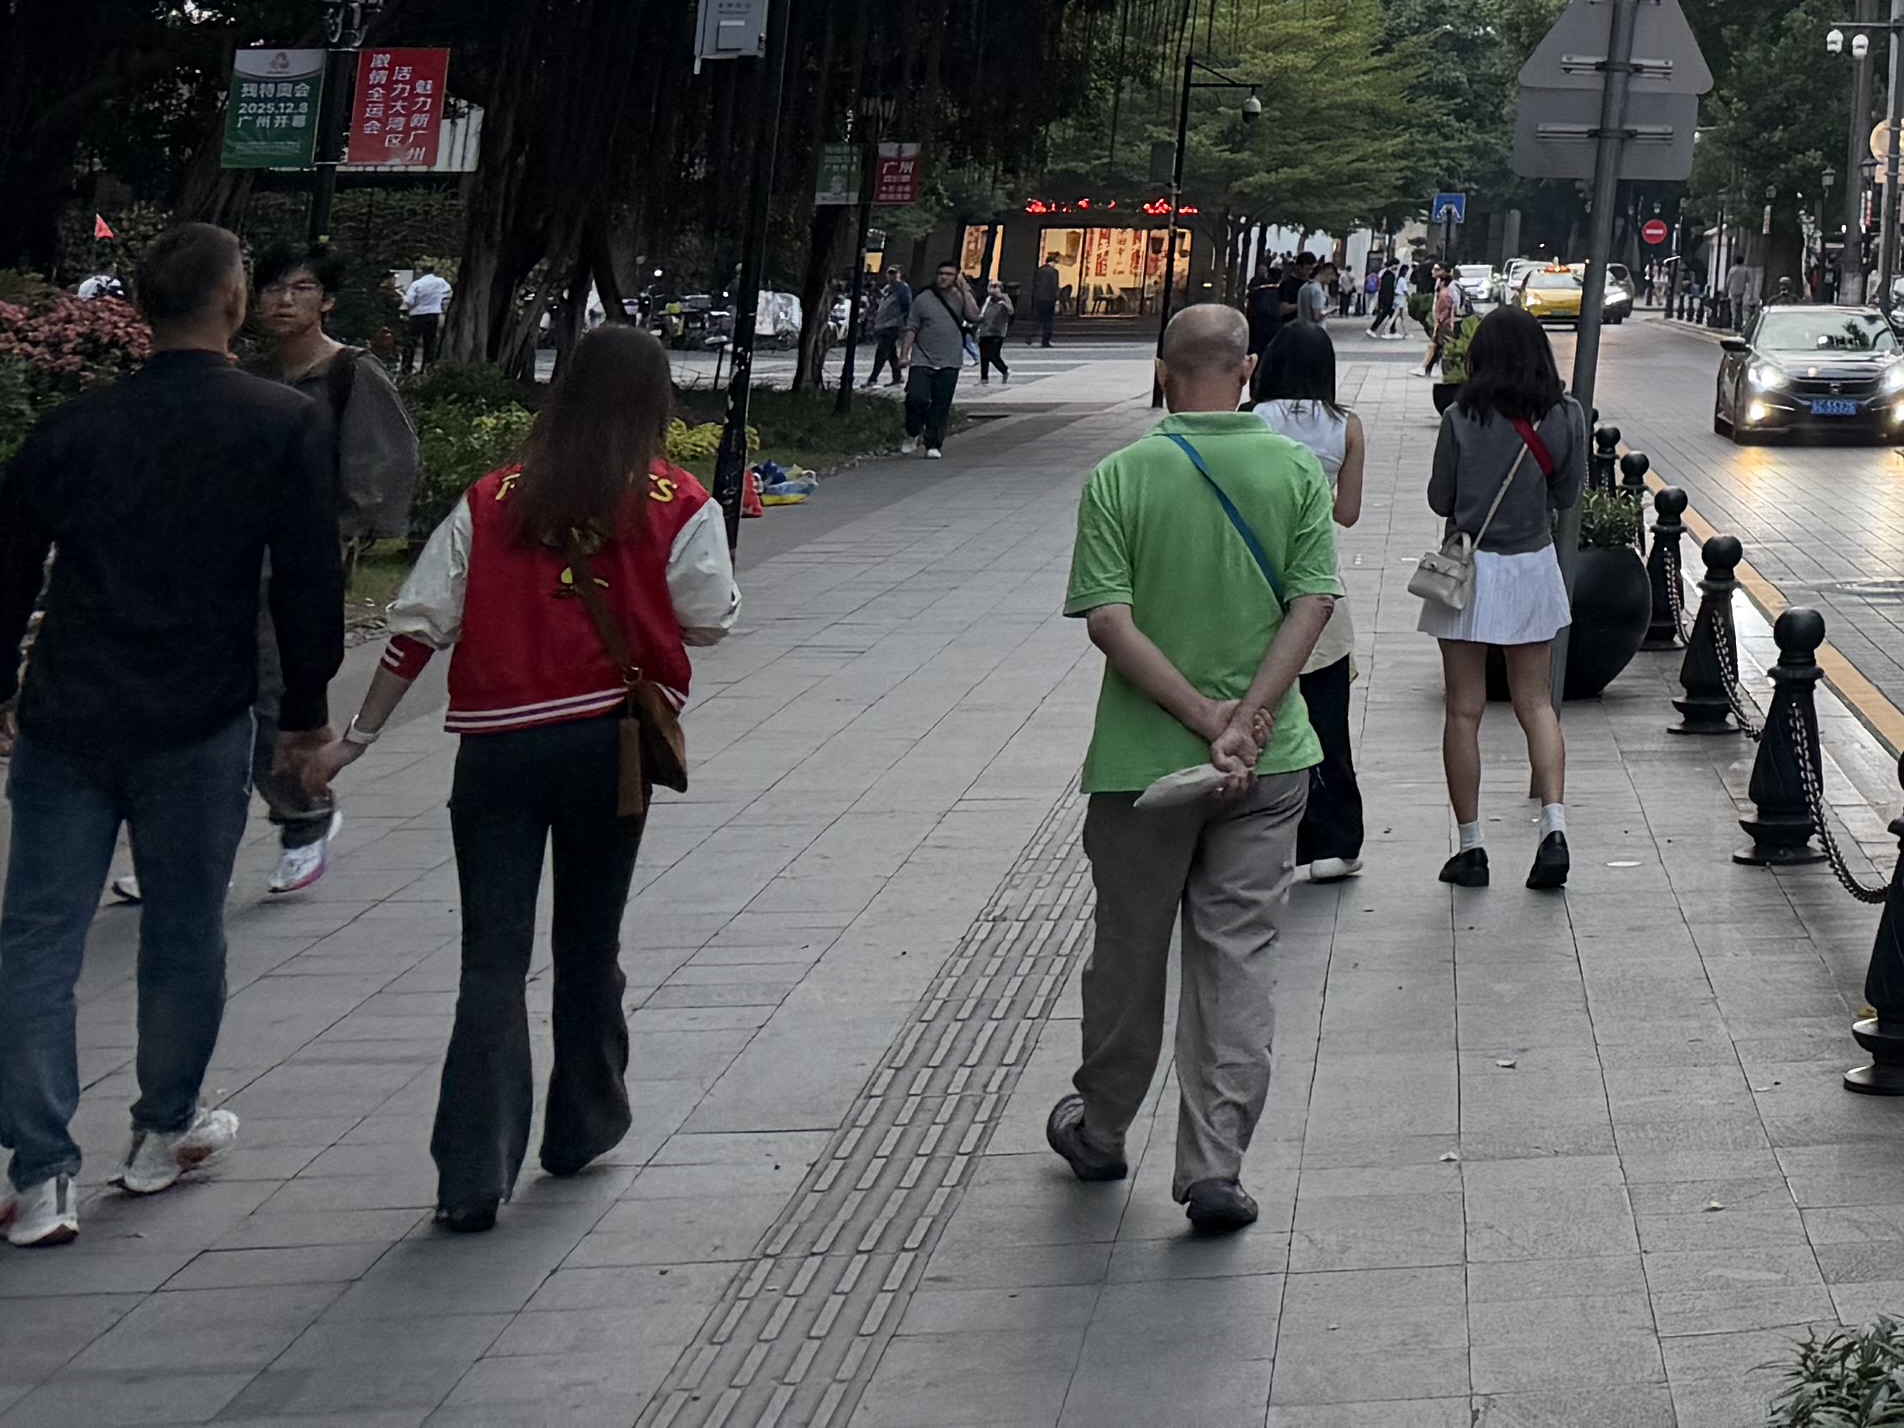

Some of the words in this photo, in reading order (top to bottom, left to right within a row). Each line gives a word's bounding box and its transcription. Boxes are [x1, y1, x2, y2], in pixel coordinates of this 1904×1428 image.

[241, 81, 311, 99] 残特奥会
[238, 101, 309, 115] 2025.12.8
[384, 66, 414, 148] 活力大湾区
[236, 115, 307, 130] 广州开幕
[407, 79, 434, 161] 魅力新广州
